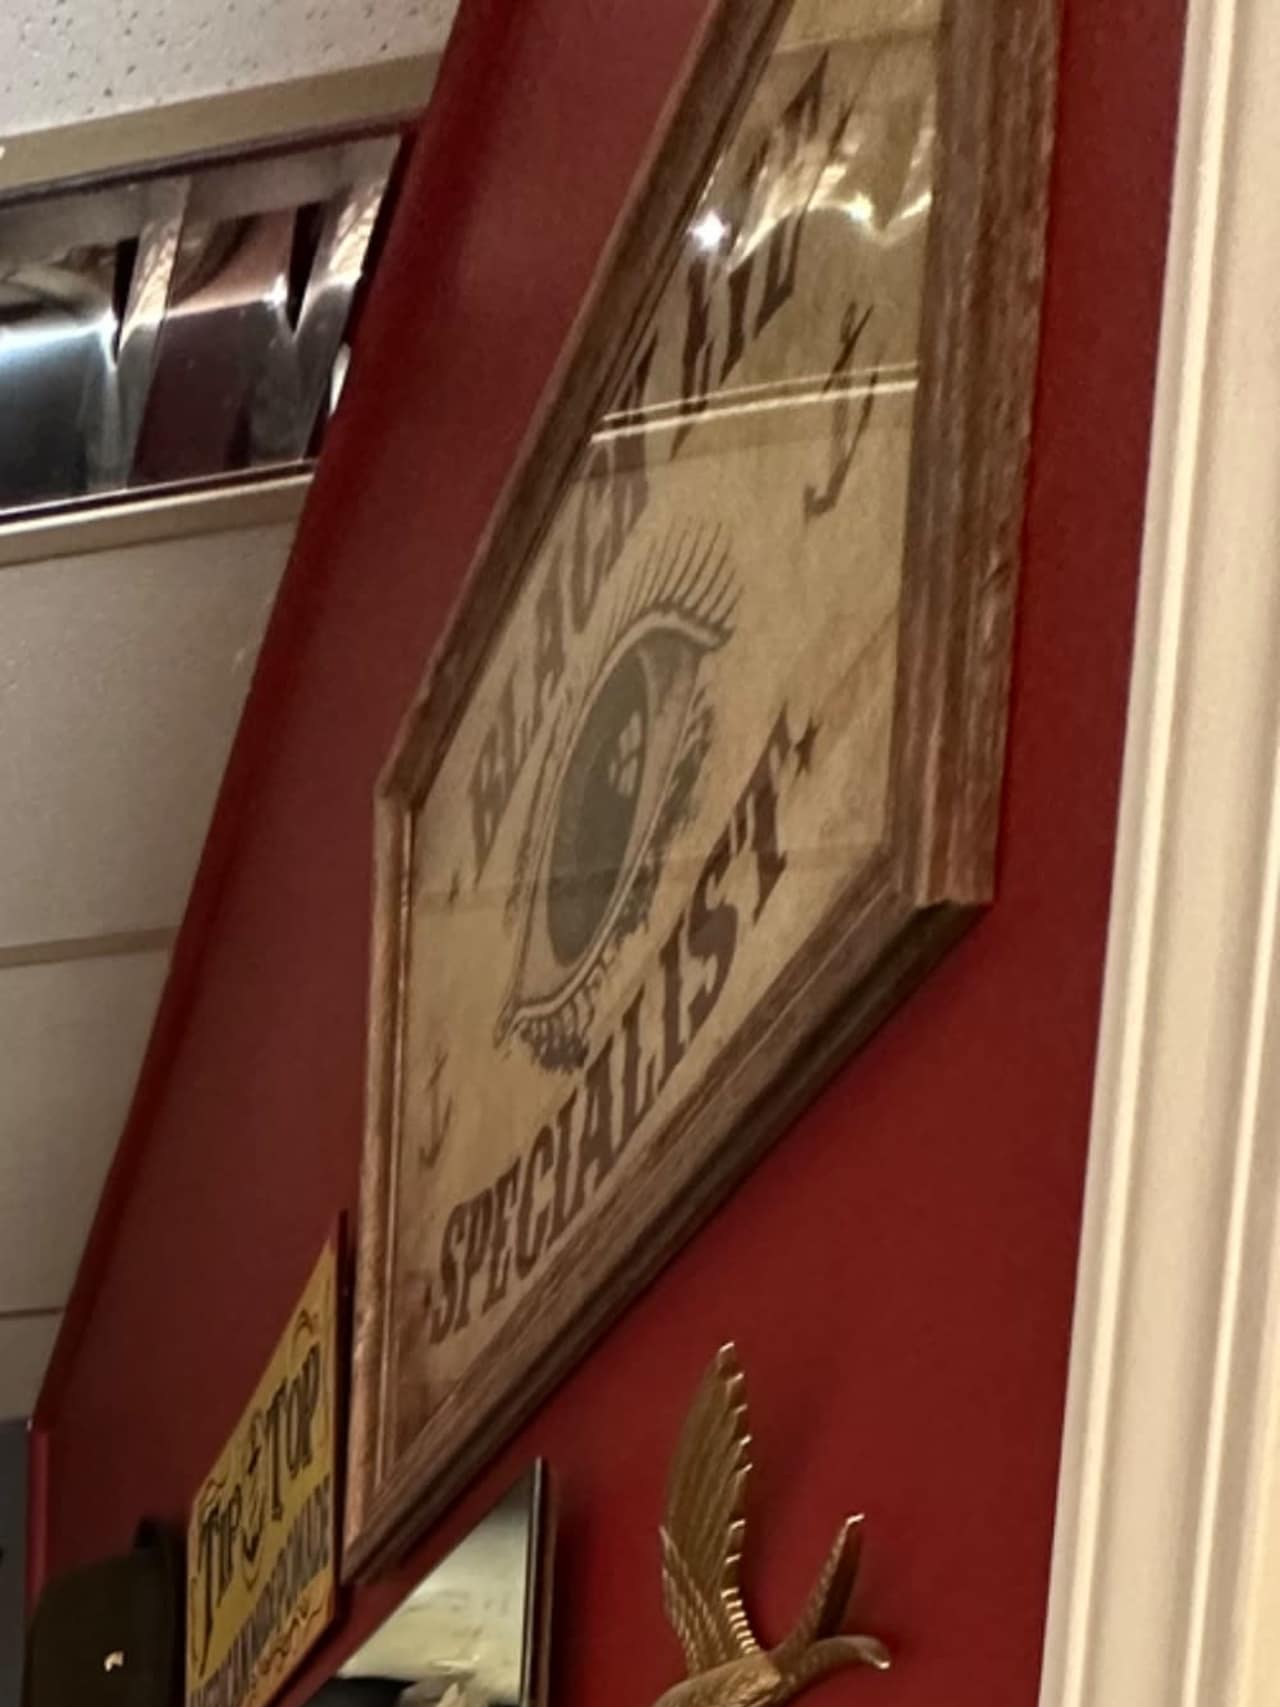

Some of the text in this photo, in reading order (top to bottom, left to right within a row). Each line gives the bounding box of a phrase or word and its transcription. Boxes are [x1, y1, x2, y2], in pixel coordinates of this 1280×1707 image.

[468, 328, 660, 890] BLACK
[430, 705, 794, 1346] SPECIALIST
[196, 1480, 242, 1680] TIP
[264, 1340, 321, 1523] TOP
